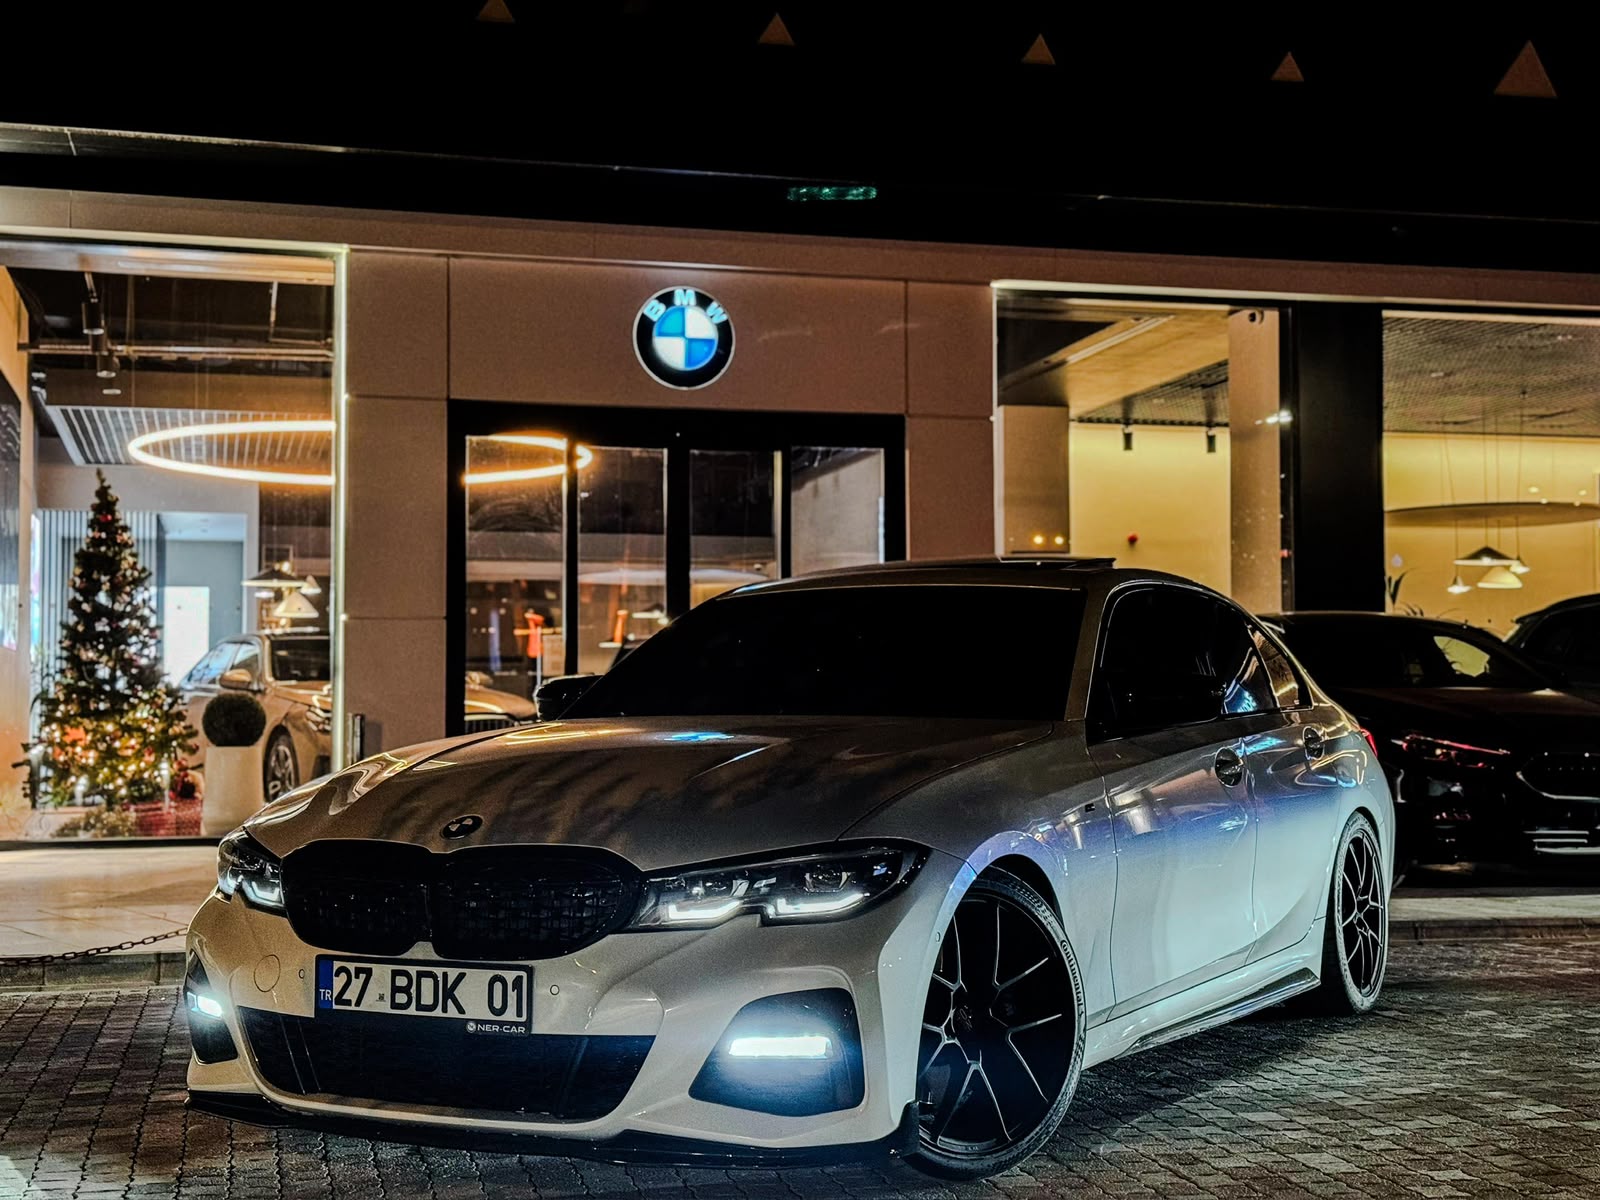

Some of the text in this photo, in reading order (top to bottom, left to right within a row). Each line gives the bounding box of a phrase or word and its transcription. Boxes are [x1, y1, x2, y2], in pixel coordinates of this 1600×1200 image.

[643, 288, 728, 324] BMW
[319, 965, 524, 1018] TR 27 BDK 01
[1060, 939, 1084, 1007] Continental
[477, 1023, 526, 1034] NER-CAR
